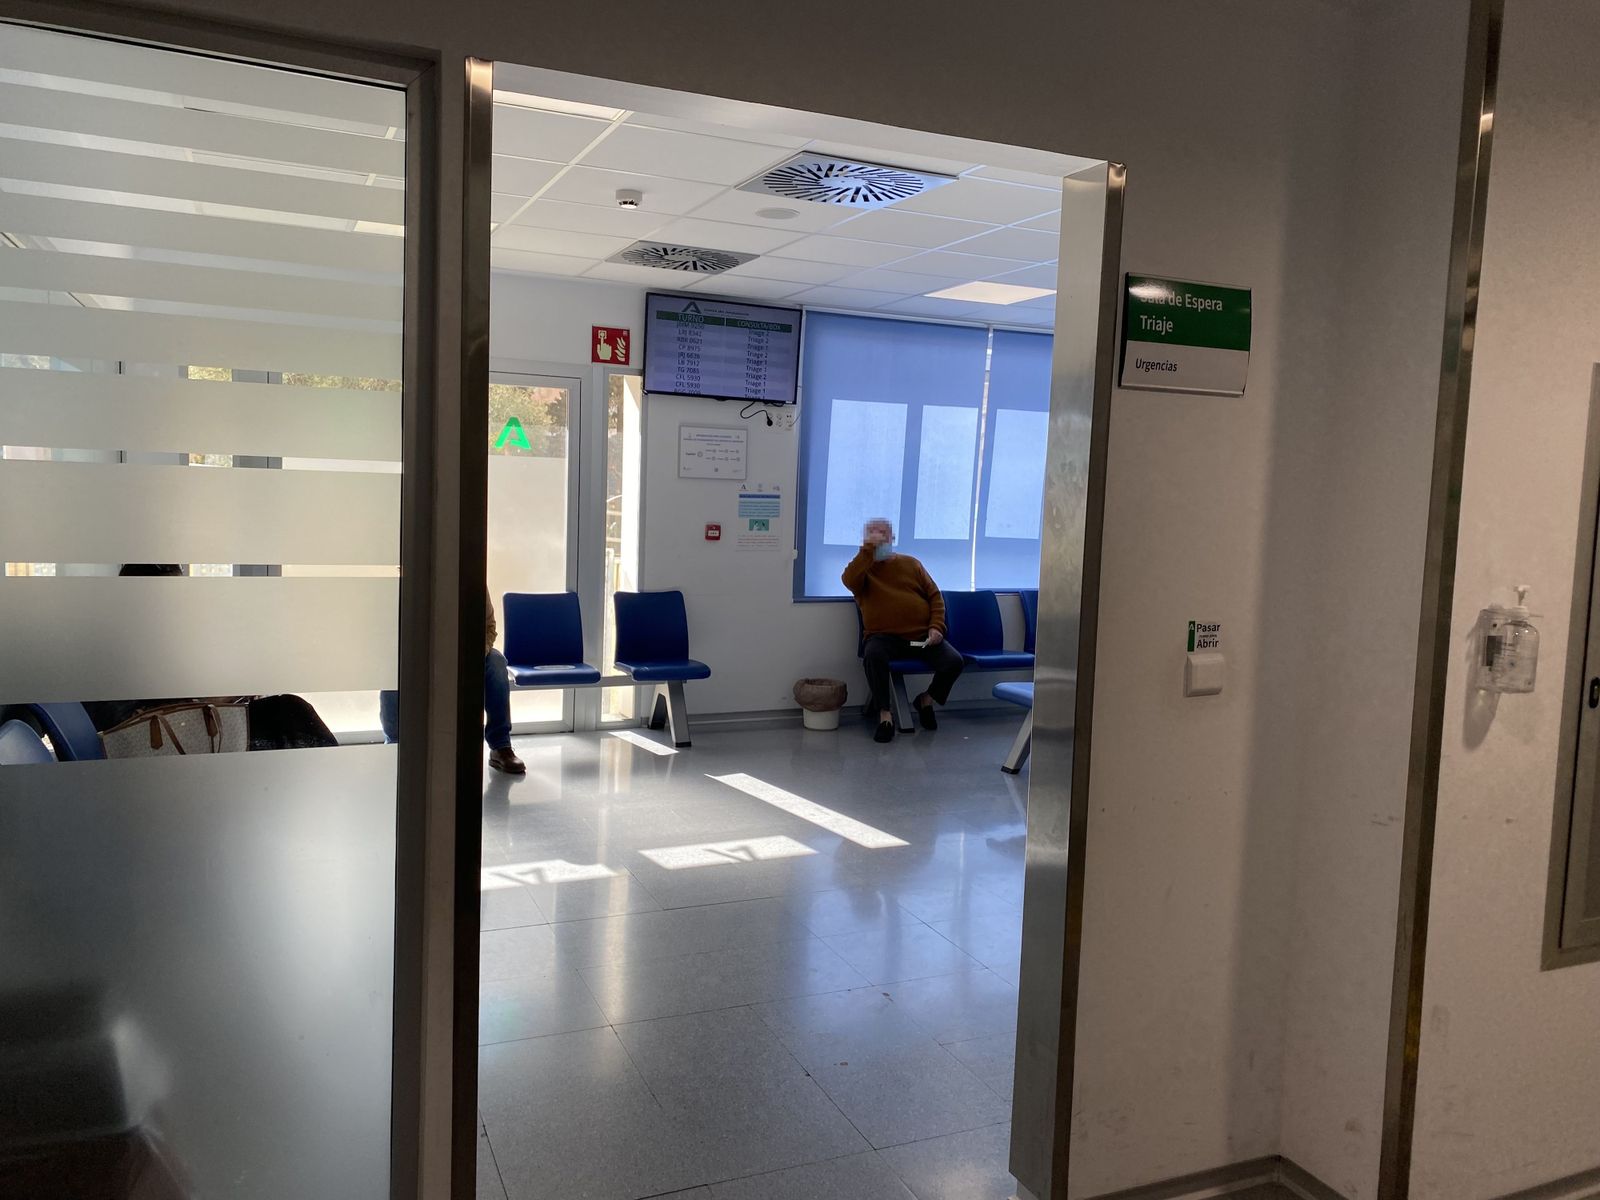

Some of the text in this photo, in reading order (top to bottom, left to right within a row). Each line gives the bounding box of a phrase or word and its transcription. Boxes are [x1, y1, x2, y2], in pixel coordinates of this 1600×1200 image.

[1168, 291, 1182, 306] de
[1185, 294, 1223, 312] Espera
[678, 313, 705, 323] TURNO
[1140, 315, 1174, 335] Triaje
[748, 336, 764, 344] Triage
[748, 343, 763, 351] Triage
[747, 350, 763, 358] Triage
[747, 358, 763, 366] Triage
[1135, 358, 1178, 372] Urgencias
[746, 365, 762, 373] Triage
[1196, 623, 1221, 632] Pasar
[1196, 638, 1219, 649] Abrir
